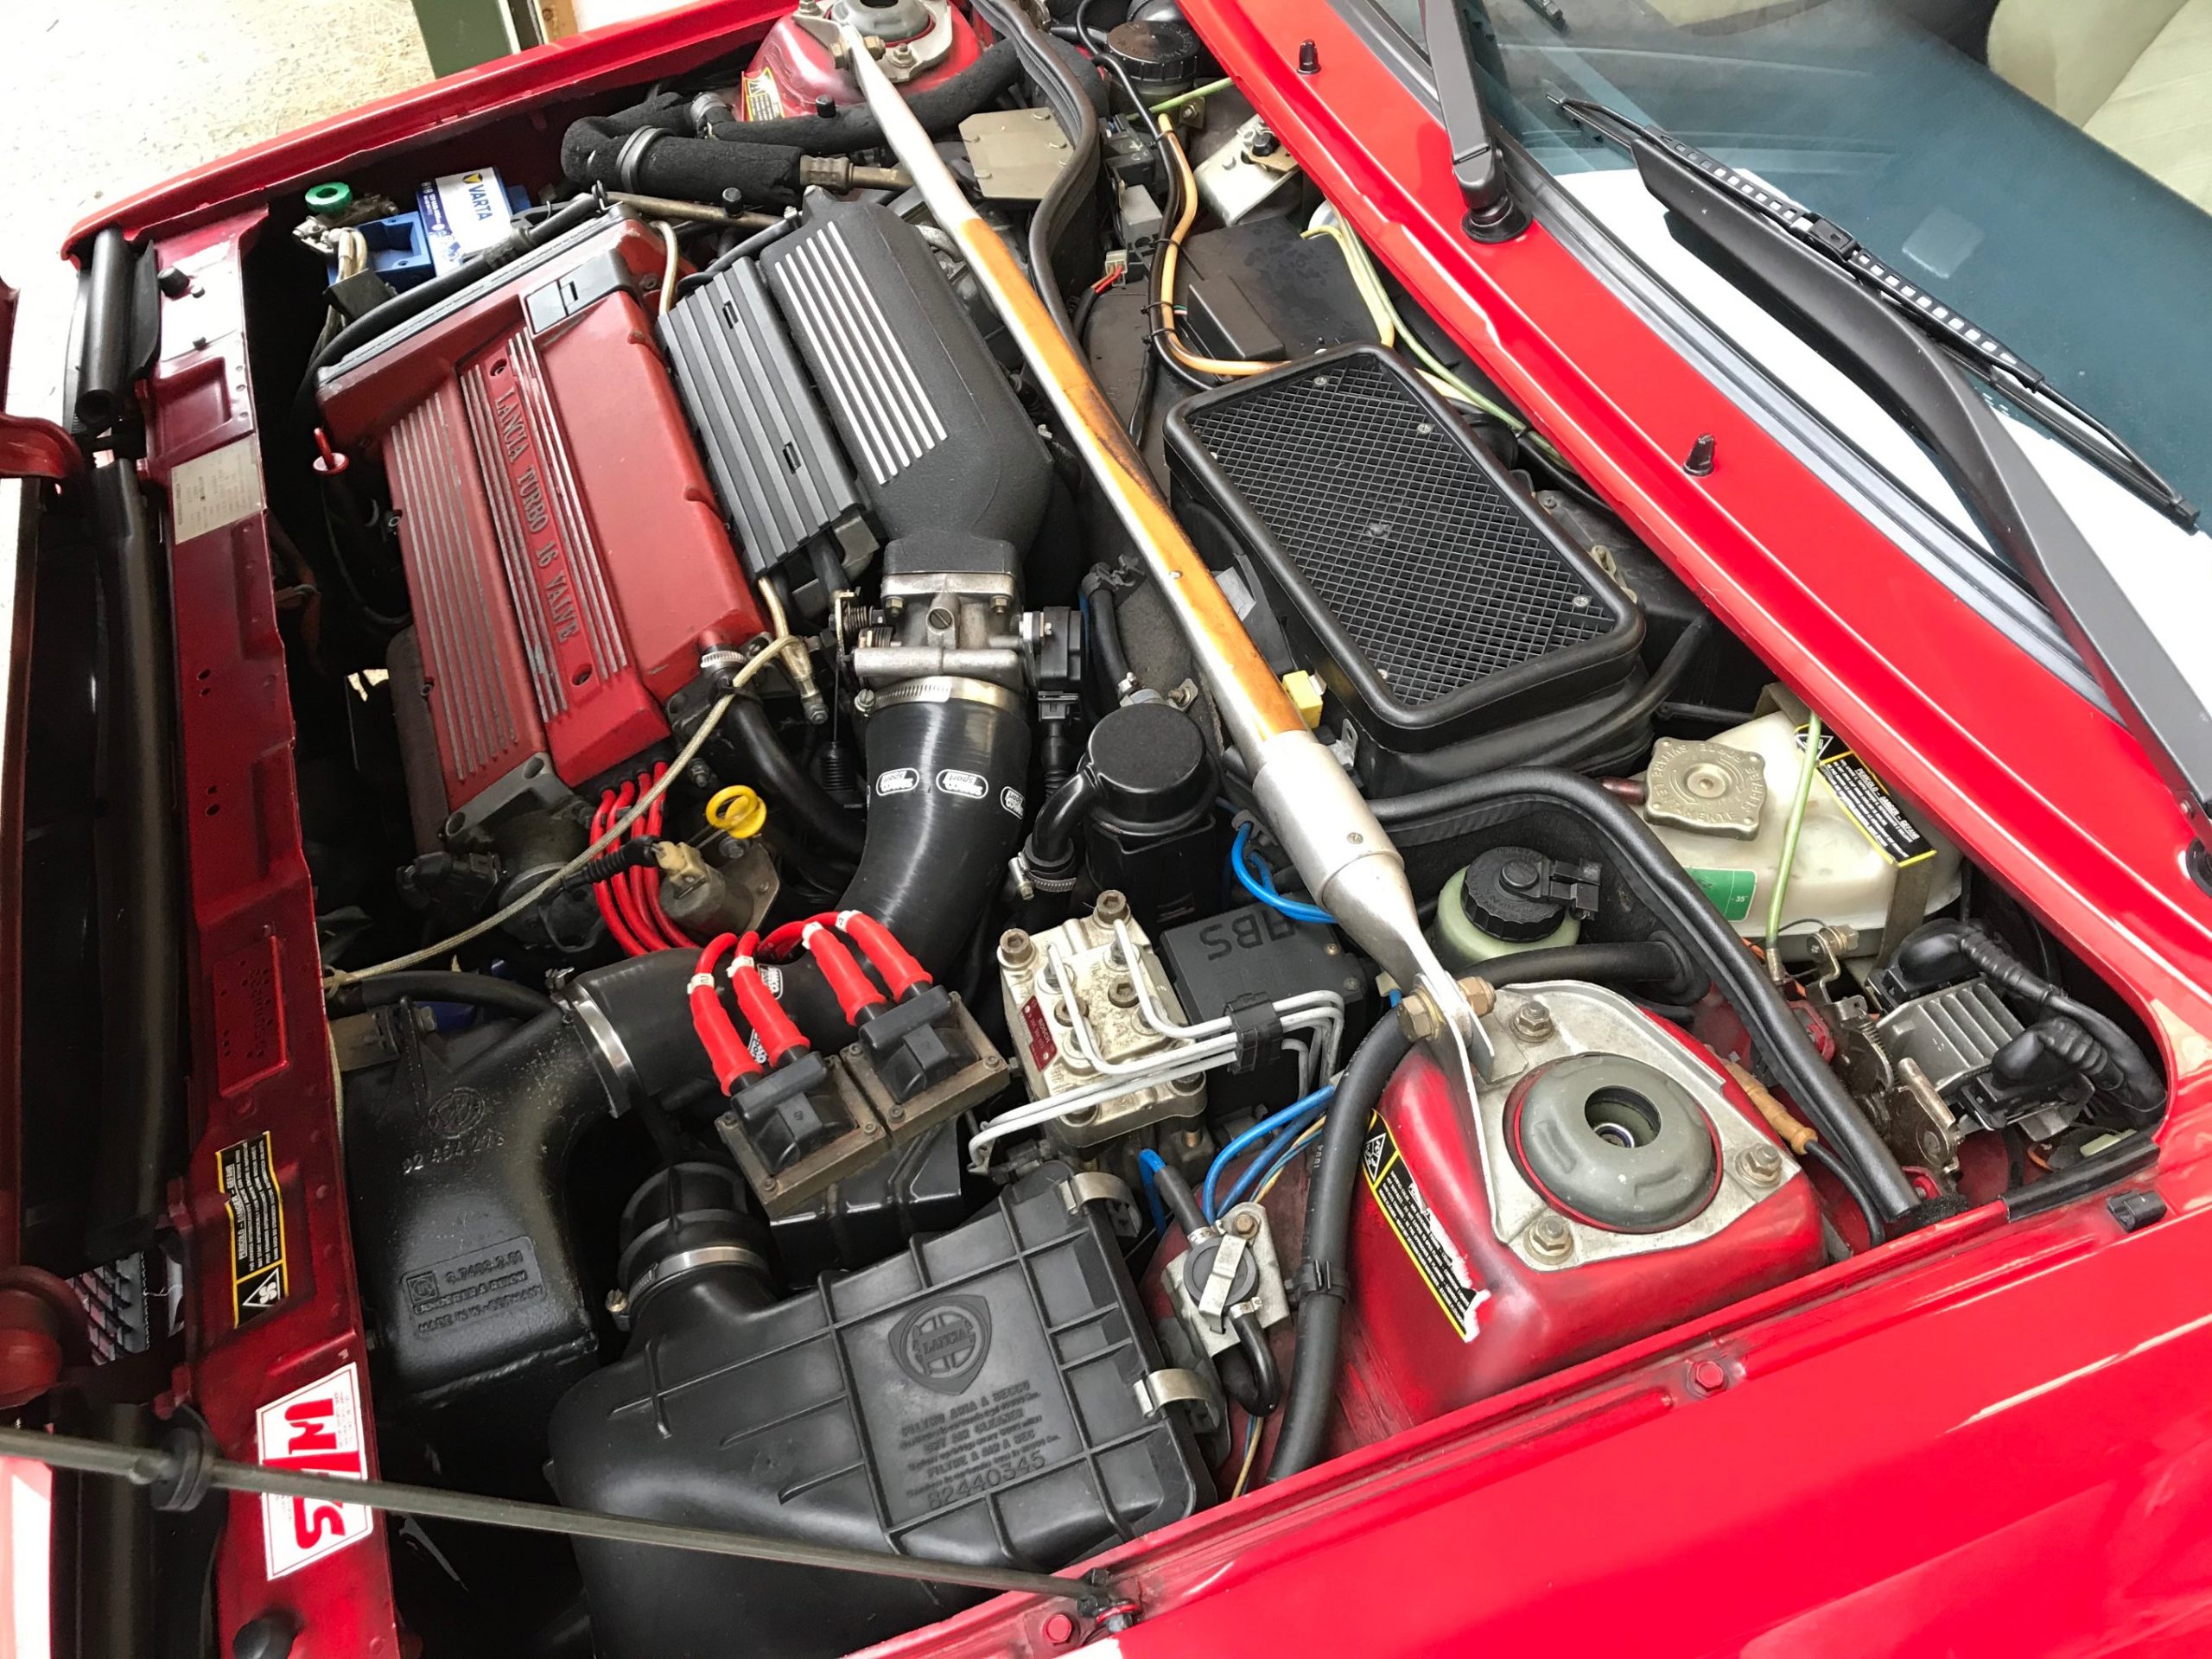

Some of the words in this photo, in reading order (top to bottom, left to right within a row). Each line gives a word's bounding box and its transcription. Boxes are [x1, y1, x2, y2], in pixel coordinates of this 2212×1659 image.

[468, 184, 493, 220] VARTA
[495, 385, 529, 464] LANCIA
[517, 464, 549, 533] TURBO
[536, 540, 559, 568] 16
[544, 570, 581, 643] VALVE
[1855, 767, 1879, 791] PERICOLO
[1878, 795, 1901, 816] DANGER
[1898, 818, 1921, 839] GEFAHR
[1198, 907, 1297, 962] ABS
[1038, 1018, 1051, 1044] BOSCH
[226, 1164, 234, 1188] GEFAHR
[232, 1195, 243, 1224] DANGER
[238, 1229, 246, 1260] PERICOLO
[418, 1313, 454, 1333] MADE
[922, 1328, 966, 1354] LANCIA
[950, 1401, 977, 1420] ARIA
[981, 1395, 990, 1408] A
[993, 1380, 1030, 1402] SECCO
[927, 1448, 1046, 1509] 82440345
